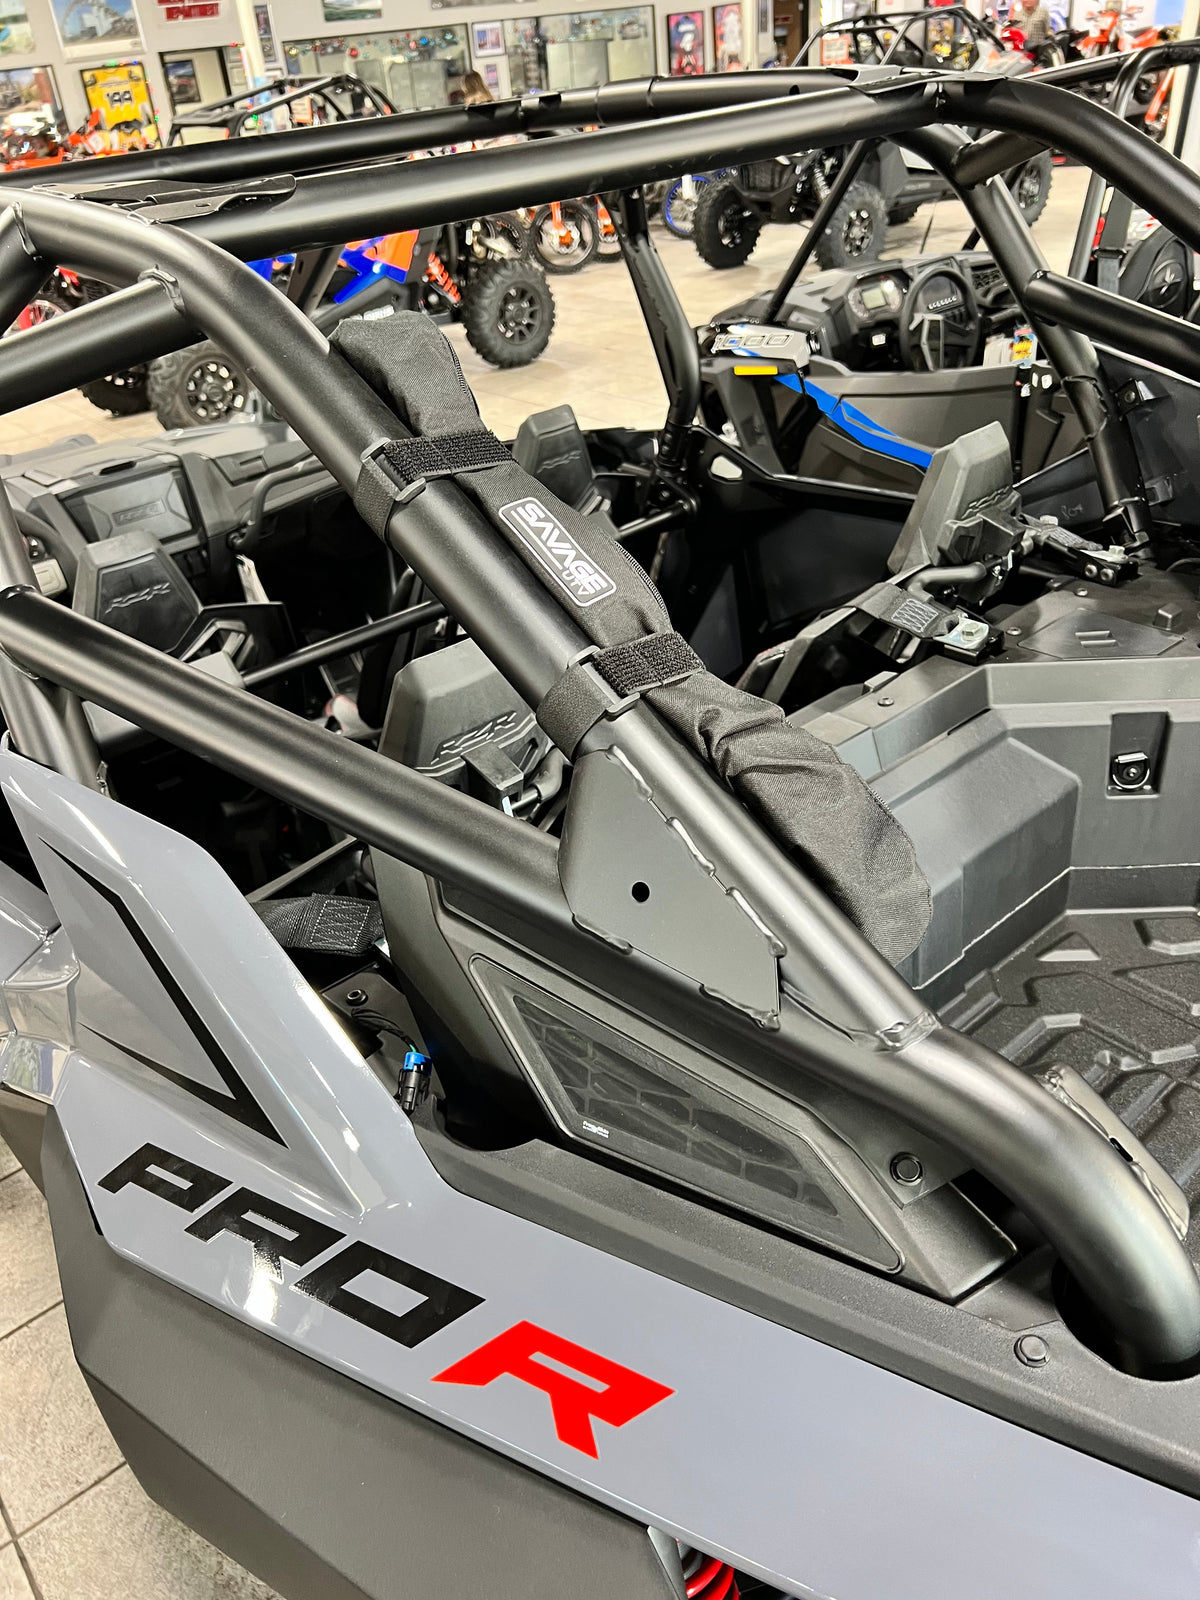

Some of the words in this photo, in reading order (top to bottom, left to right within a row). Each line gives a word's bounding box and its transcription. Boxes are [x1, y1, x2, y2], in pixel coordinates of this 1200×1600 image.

[516, 502, 608, 595] SAVAGE
[561, 569, 591, 596] UTV
[97, 1142, 486, 1349] PRO
[430, 1319, 676, 1461] R
